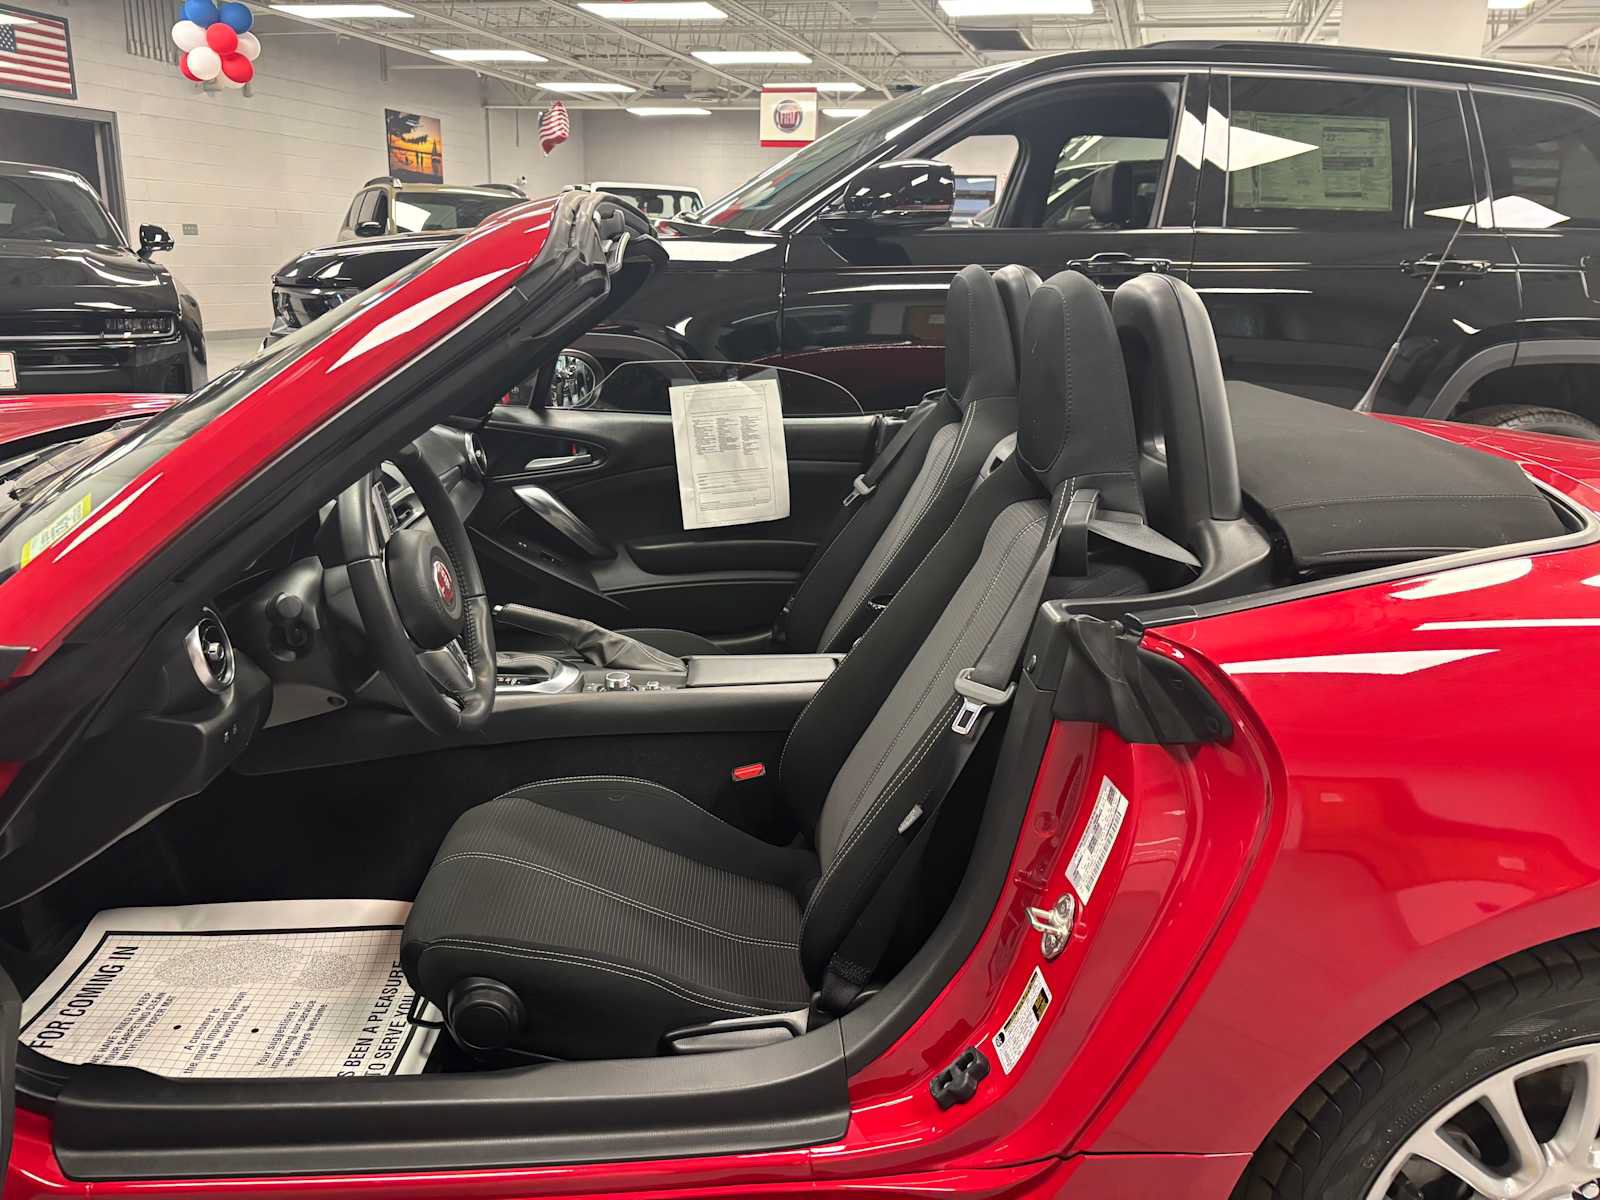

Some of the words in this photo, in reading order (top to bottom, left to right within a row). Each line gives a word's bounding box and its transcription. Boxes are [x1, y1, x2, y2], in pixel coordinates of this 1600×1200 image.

[29, 1020, 74, 1049] FOR
[60, 964, 125, 1017] COMING
[109, 946, 139, 960] IN
[367, 960, 405, 1022] PLEASURE
[89, 1054, 103, 1064] WE
[97, 1035, 118, 1053] HAVE
[112, 1017, 133, 1034] TRIED
[128, 1007, 140, 1016] TO
[136, 992, 152, 1006] KEEP
[102, 1046, 121, 1064] YOUR
[117, 1011, 151, 1046] CARPETING
[145, 992, 167, 1011] CLEAN
[119, 1043, 138, 1060] WITH
[132, 1028, 150, 1043] THIS
[145, 1008, 167, 1028] PAPER
[183, 1062, 198, 1074] the
[193, 1043, 211, 1061] most
[203, 1011, 232, 1041] important
[227, 991, 248, 1011] person
[189, 1014, 215, 1044] customer
[212, 1039, 226, 1052] the
[223, 1020, 239, 1039] world
[255, 1051, 272, 1067] Your
[267, 1011, 297, 1050] suggestions
[289, 1001, 302, 1010] for
[267, 1035, 298, 1069] improving
[291, 1022, 303, 1035] our
[297, 1000, 317, 1022] service
[284, 1057, 297, 1068] are
[292, 1032, 312, 1057] always
[343, 1038, 374, 1067] BEEN
[362, 1025, 381, 1034] A
[374, 1021, 407, 1059] SERVE
[364, 1063, 386, 1077] TO
